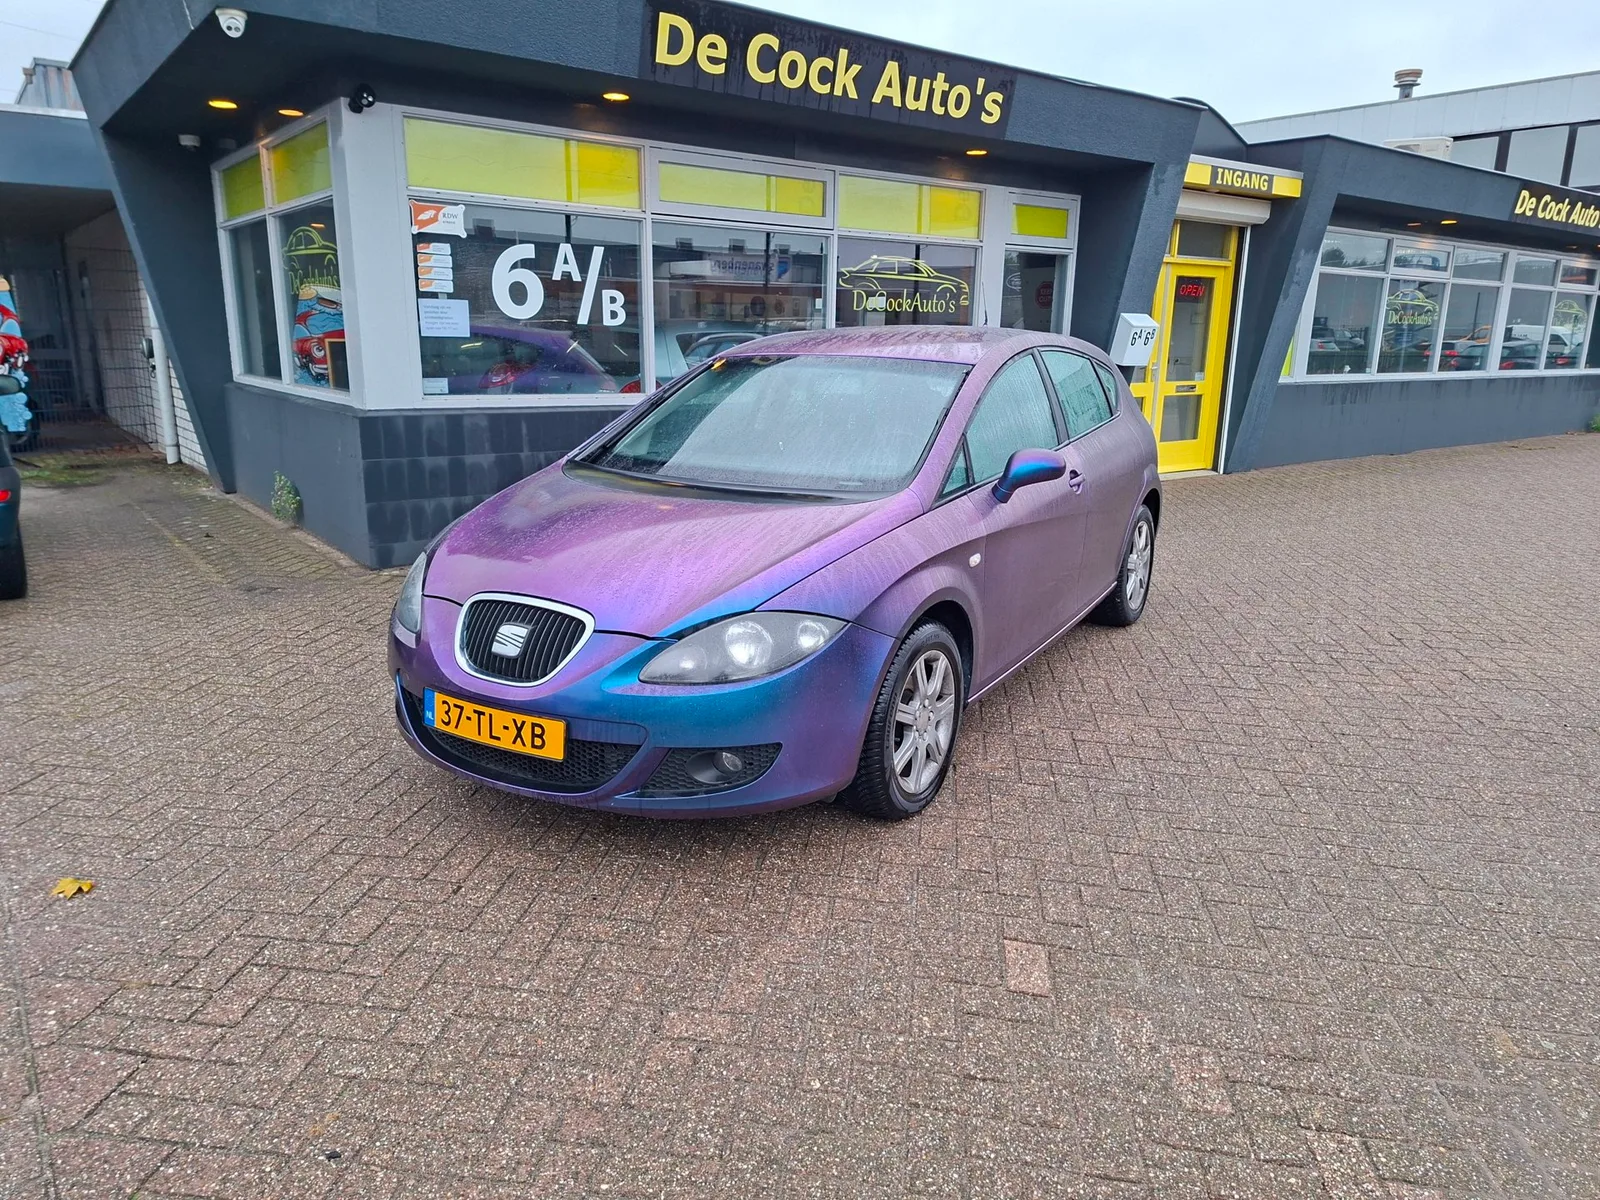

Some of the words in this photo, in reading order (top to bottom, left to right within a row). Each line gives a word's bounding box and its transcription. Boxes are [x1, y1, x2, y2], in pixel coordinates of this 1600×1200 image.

[655, 12, 728, 75] De
[746, 33, 862, 99] Cock
[872, 60, 1004, 125] Auto's
[1216, 168, 1269, 191] INGANG
[1514, 190, 1537, 217] De
[1537, 194, 1571, 223] Cock
[1568, 201, 1600, 229] Auto
[1180, 284, 1205, 297] OPEN
[441, 700, 546, 750] 37-TL-XB
